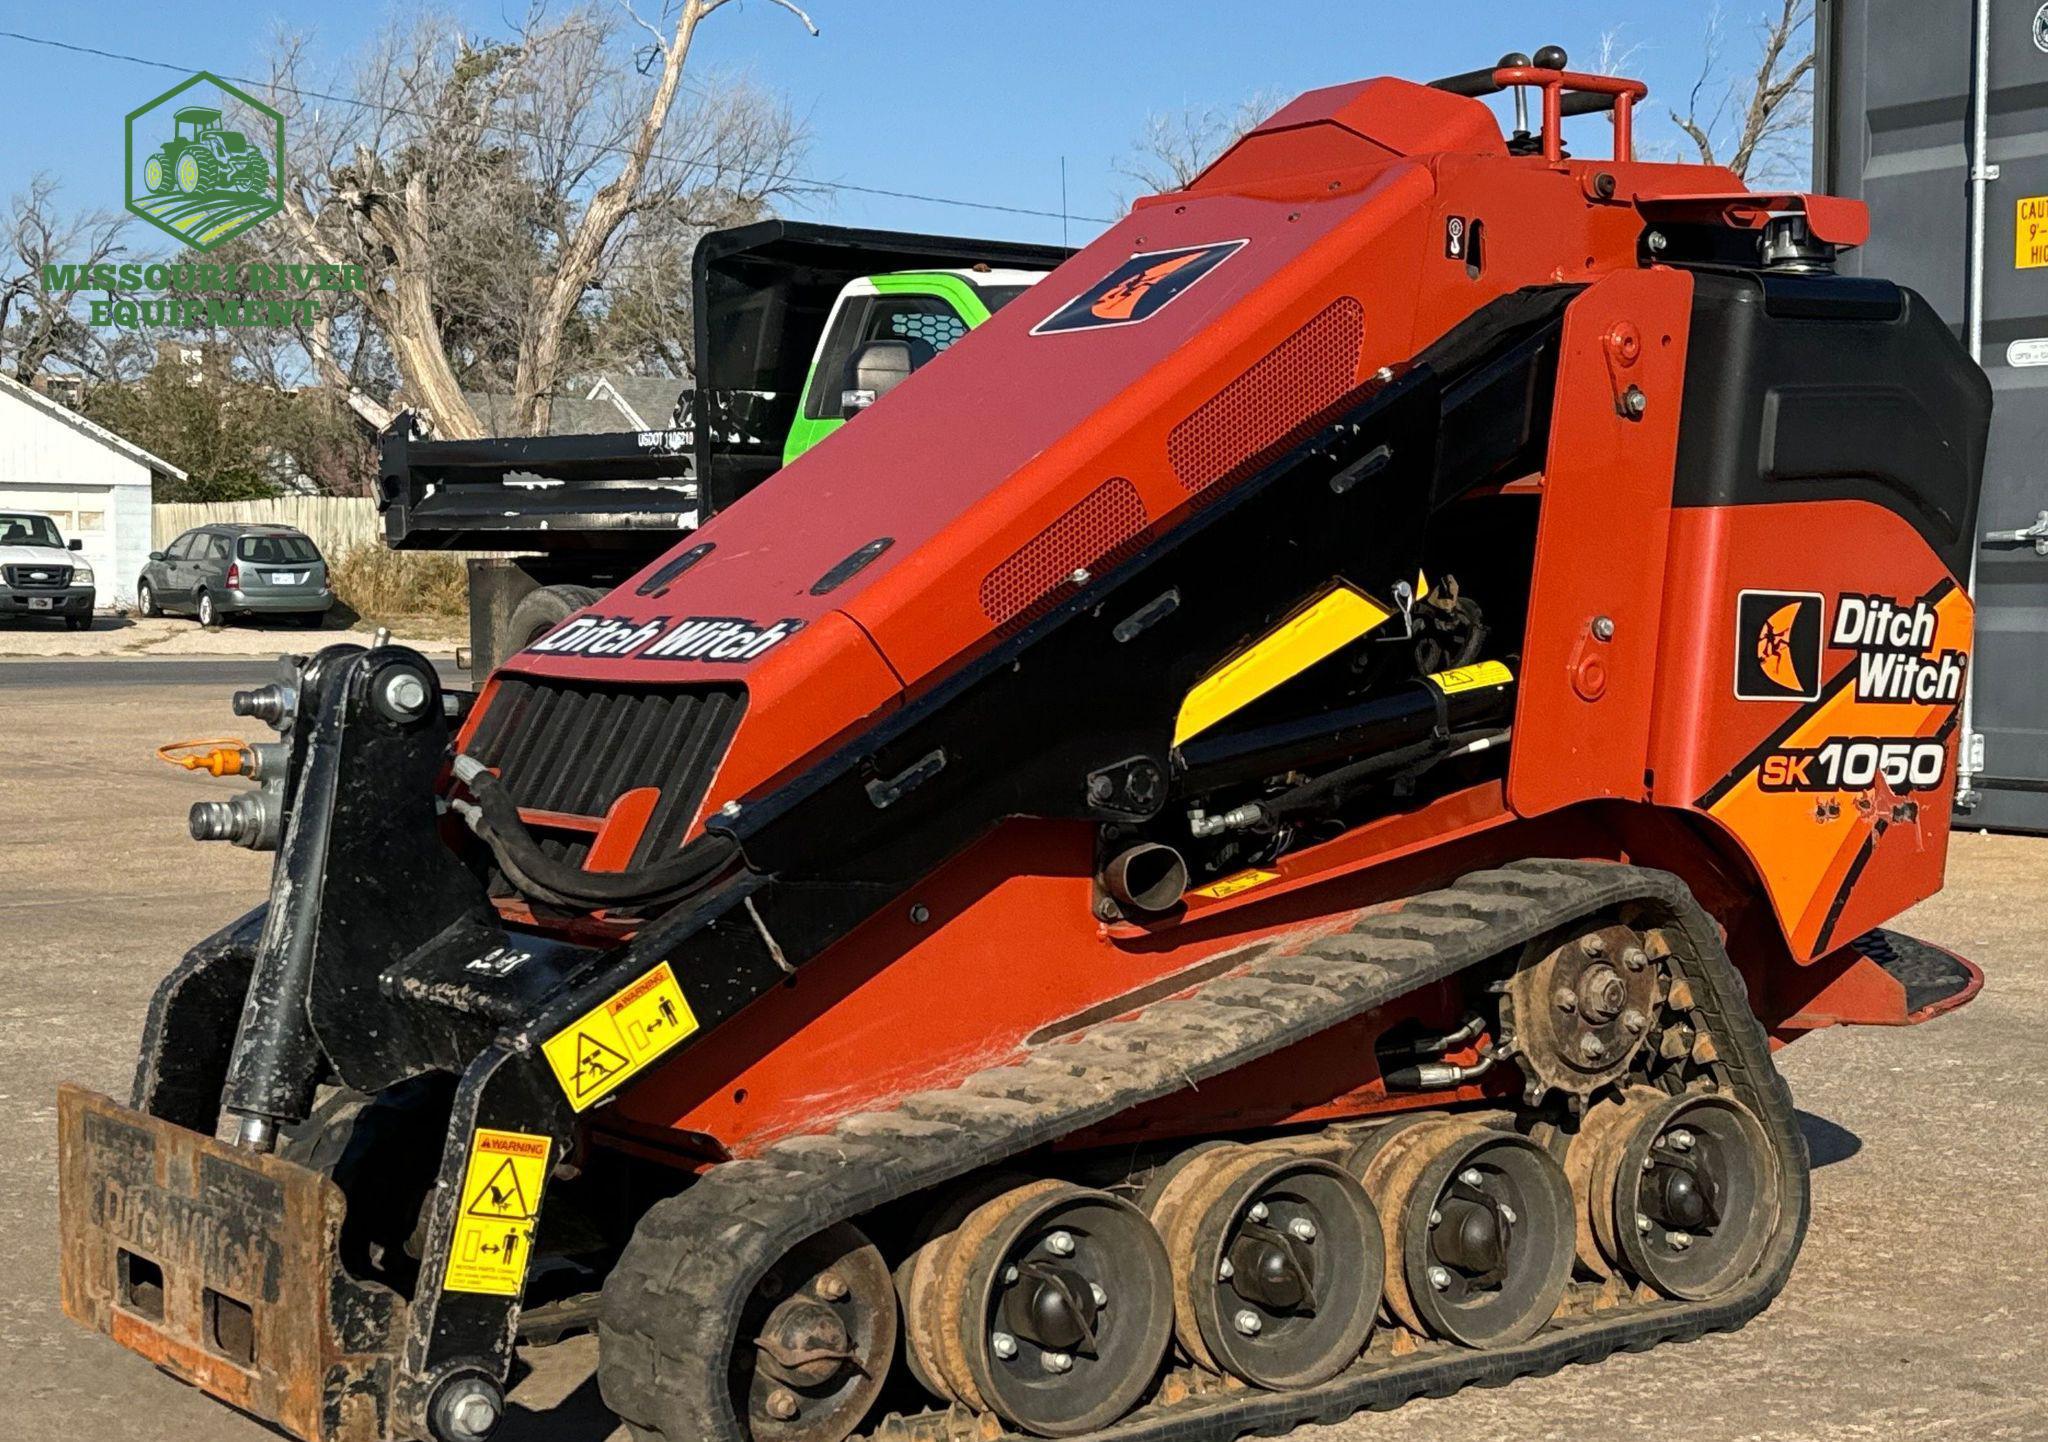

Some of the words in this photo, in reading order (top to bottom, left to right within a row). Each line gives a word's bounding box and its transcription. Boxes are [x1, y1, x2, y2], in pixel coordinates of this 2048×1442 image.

[531, 618, 660, 653] Ditch
[643, 620, 787, 660] Witch
[1833, 598, 1935, 647] Ditch
[1858, 652, 1961, 700] Witch
[1762, 755, 1815, 786] SK
[1818, 743, 1945, 786] 1050
[621, 971, 665, 1005] WARNING
[491, 1138, 544, 1155] WARNING
